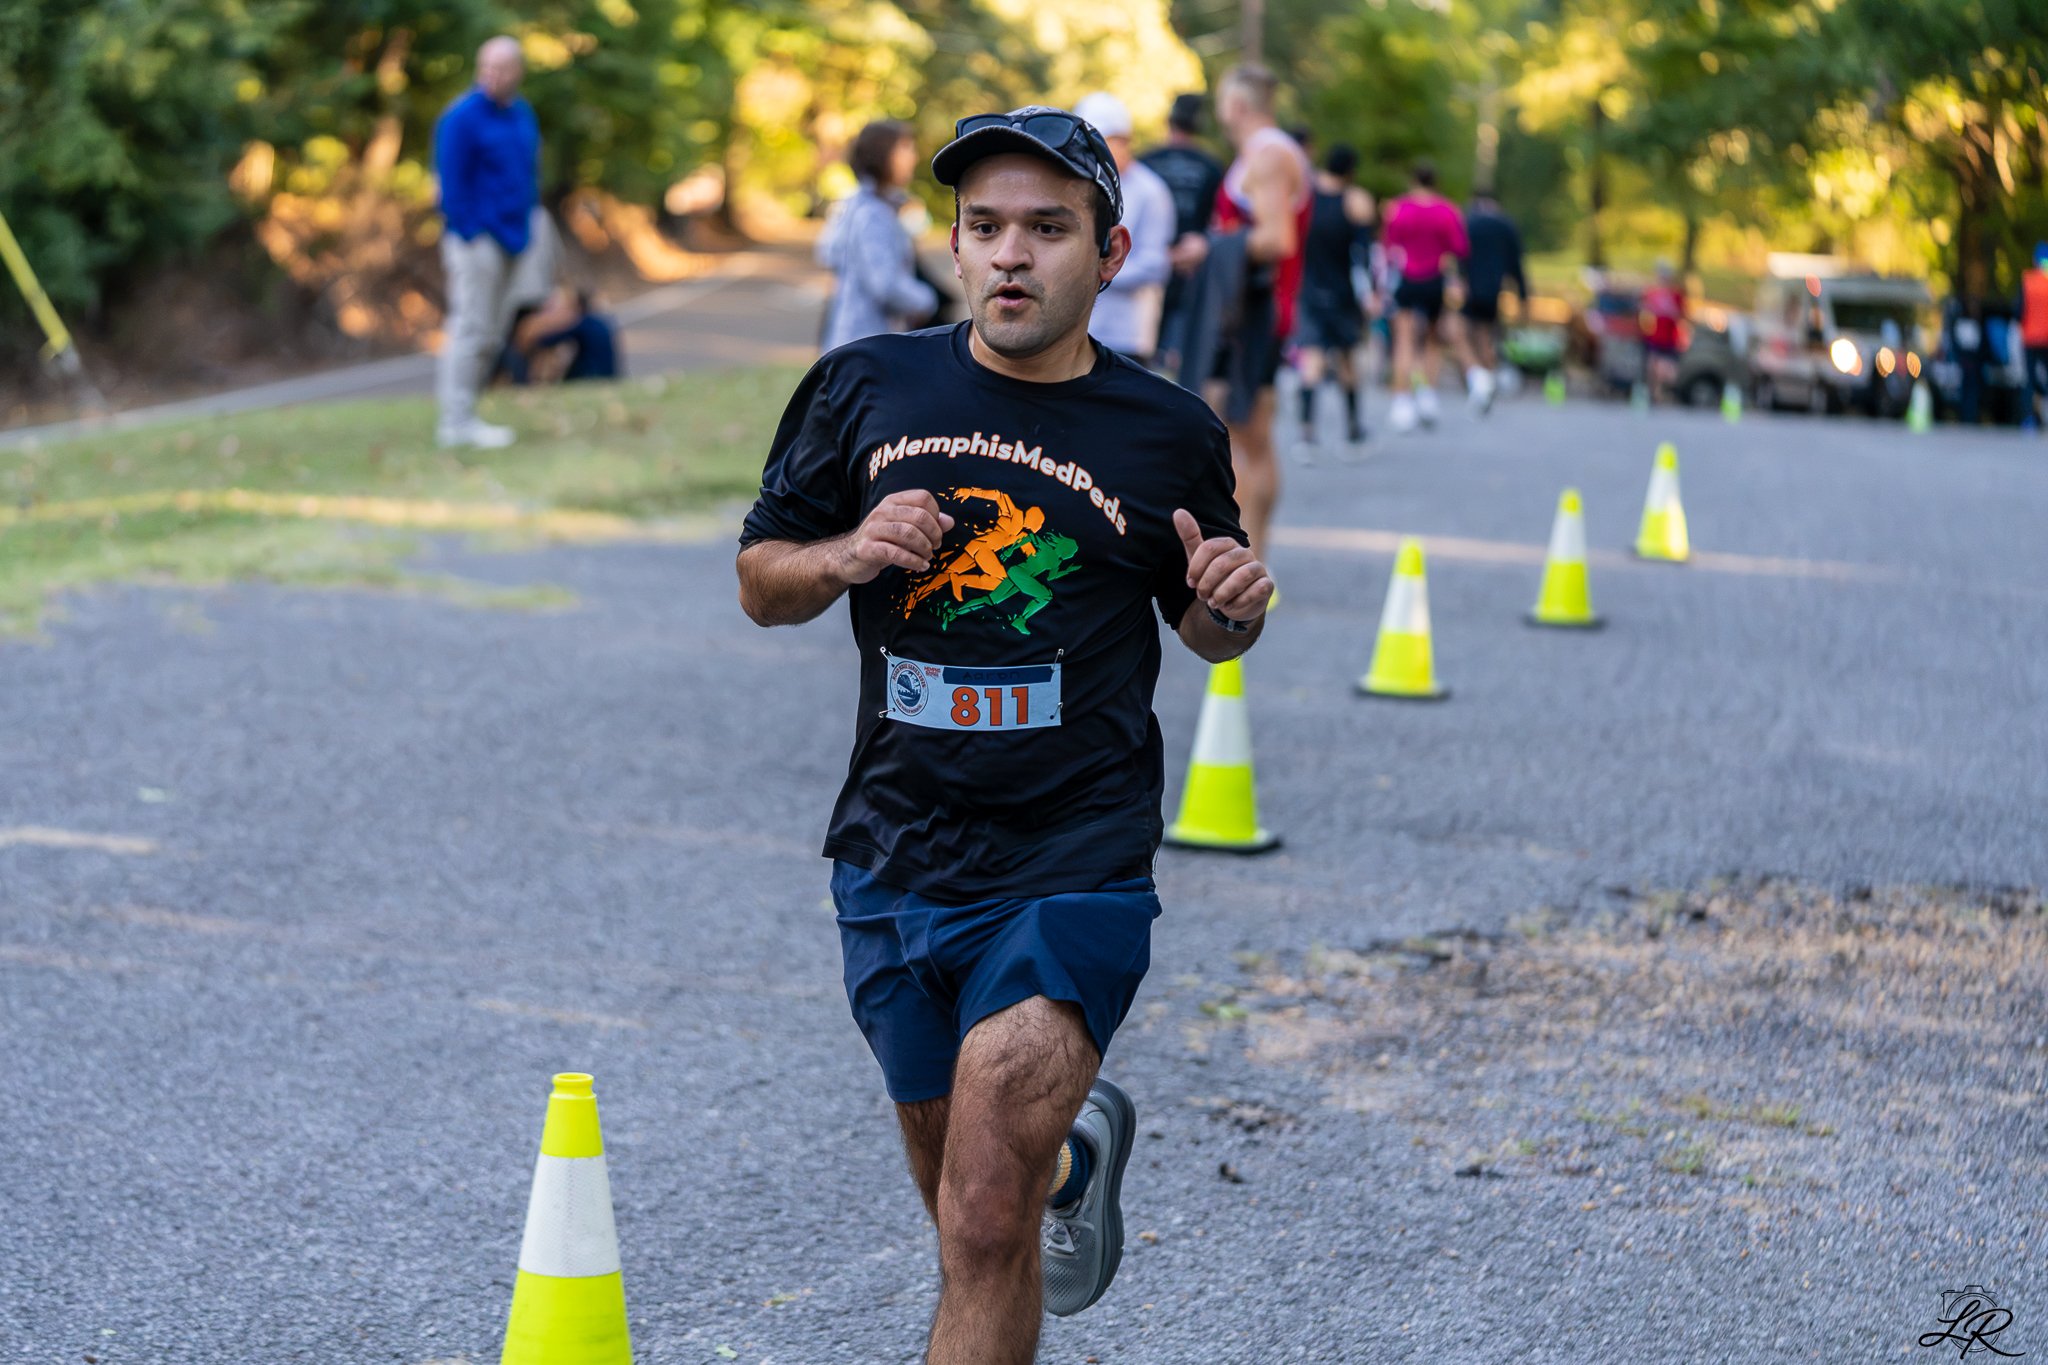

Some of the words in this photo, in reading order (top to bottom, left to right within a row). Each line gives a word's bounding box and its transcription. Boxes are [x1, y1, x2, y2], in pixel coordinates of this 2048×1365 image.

[868, 431, 1127, 536] #MemphisMedPeds
[962, 671, 1021, 680] Aaron
[950, 686, 1029, 726] 811
